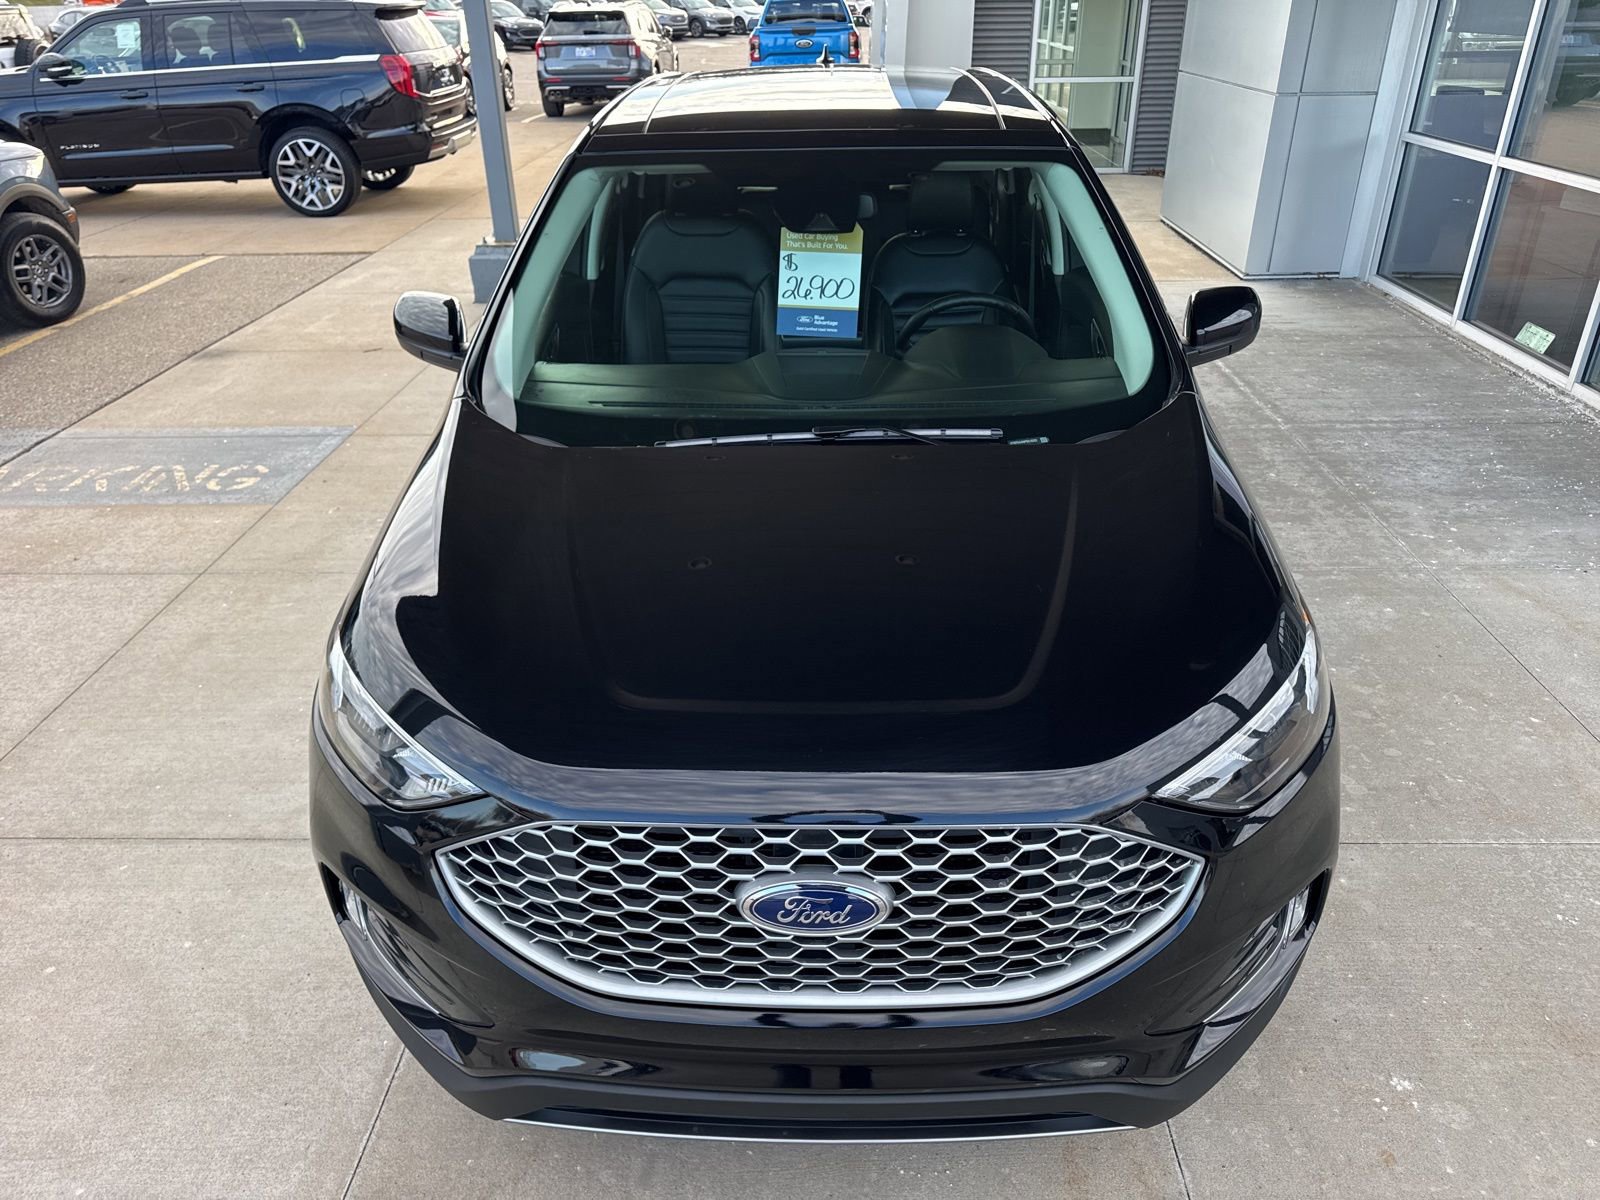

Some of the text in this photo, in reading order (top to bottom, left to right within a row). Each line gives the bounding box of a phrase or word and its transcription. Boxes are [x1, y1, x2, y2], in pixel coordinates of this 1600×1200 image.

[786, 232, 803, 240] Used
[816, 233, 839, 242] Buying
[786, 240, 805, 248] That's
[806, 241, 821, 249] Built
[835, 242, 849, 250] You.
[782, 252, 798, 272] $
[776, 895, 853, 925] Ford
